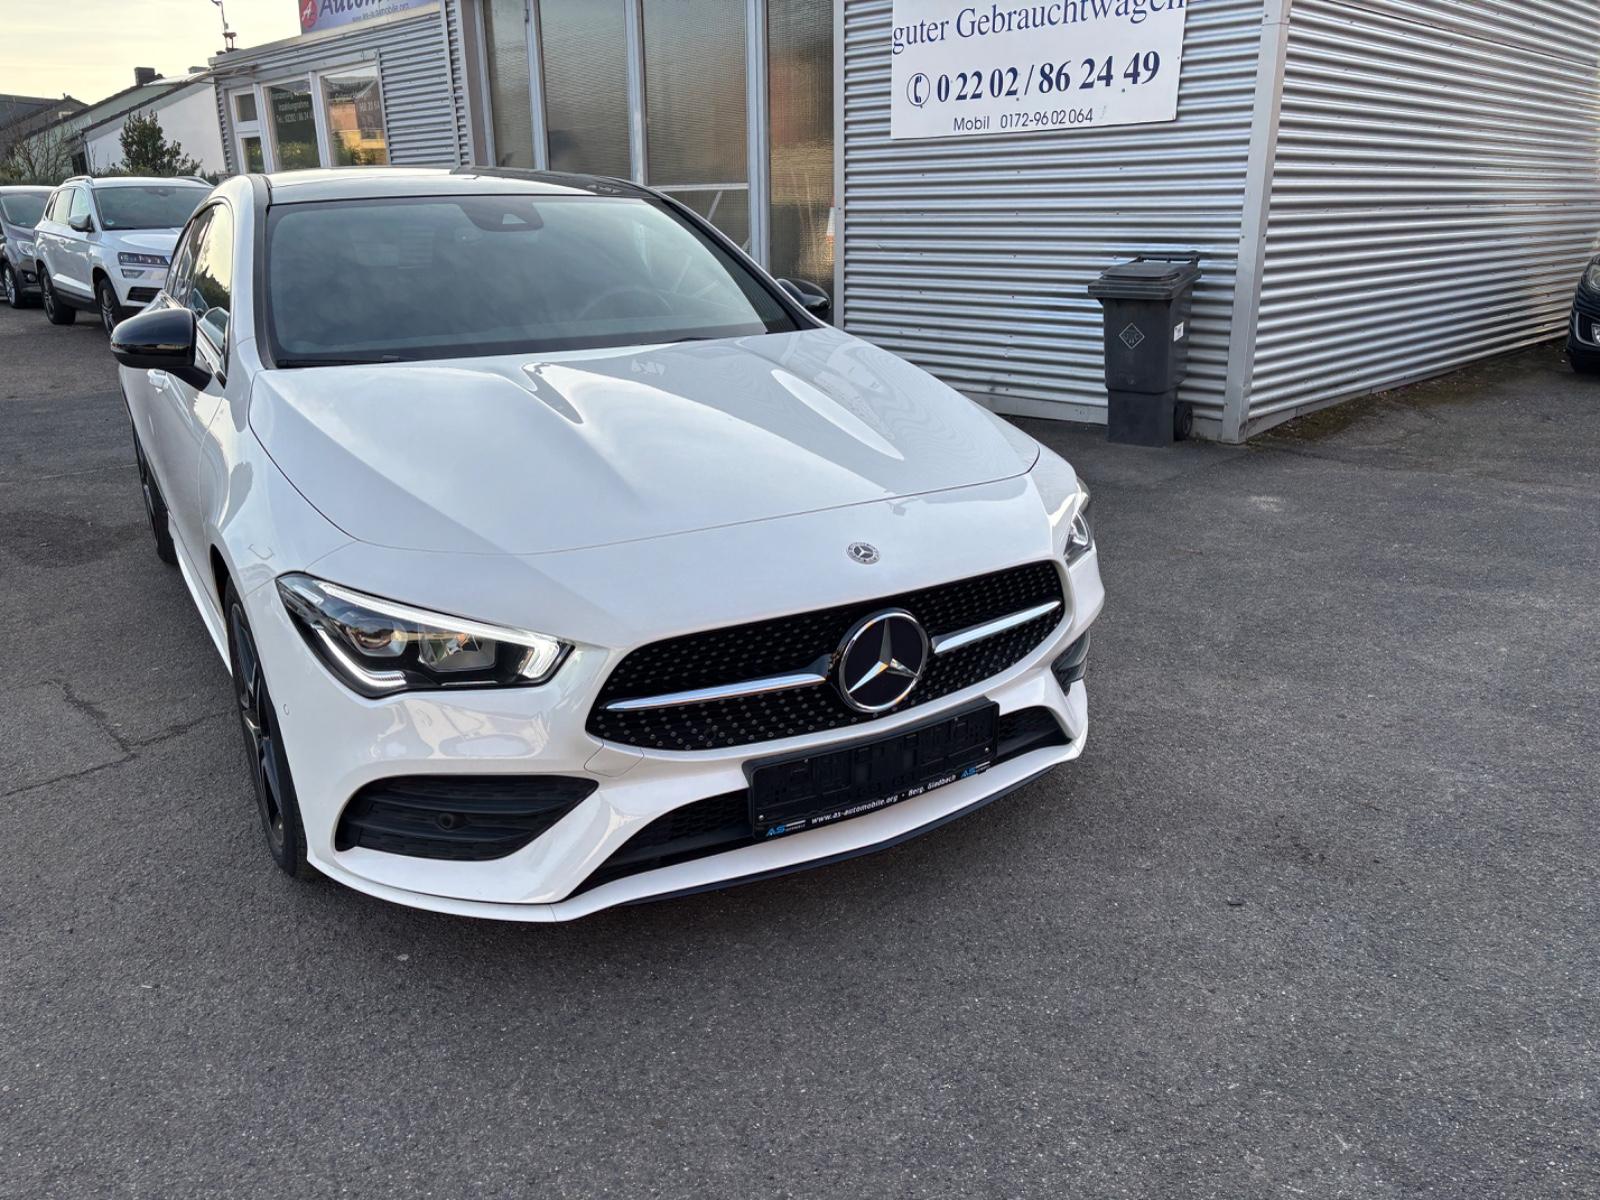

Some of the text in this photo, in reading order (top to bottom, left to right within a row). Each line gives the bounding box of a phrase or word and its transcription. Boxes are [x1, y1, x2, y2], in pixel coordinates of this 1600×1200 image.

[892, 19, 949, 55] guter
[953, 115, 991, 131] Mobil
[811, 794, 899, 825] www.as-automobile.org
